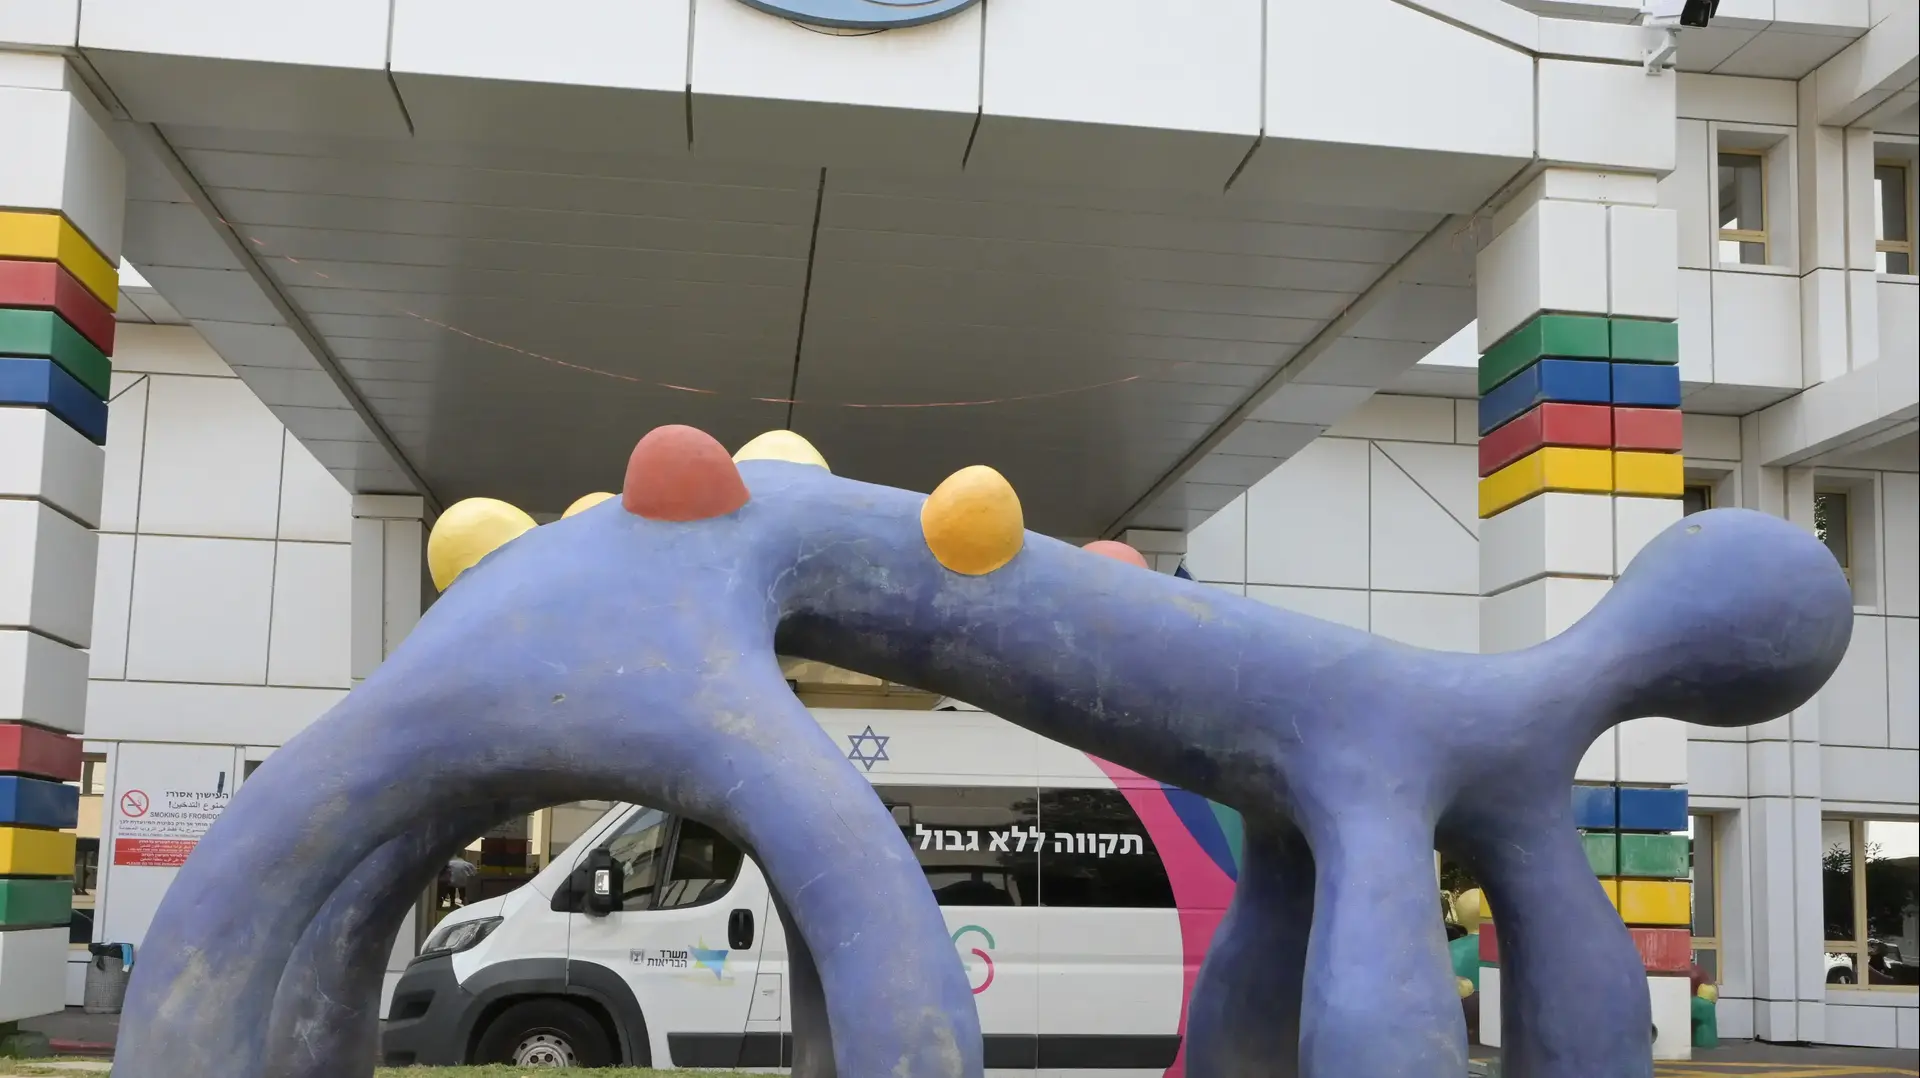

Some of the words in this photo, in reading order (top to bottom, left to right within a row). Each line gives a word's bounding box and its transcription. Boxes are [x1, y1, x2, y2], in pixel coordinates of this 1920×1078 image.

[196, 792, 229, 800] העישון
[149, 811, 180, 819] SMOKING
[188, 812, 220, 820] FROBIDD
[915, 823, 980, 852] גבול
[988, 825, 1046, 853] ללא
[1054, 831, 1144, 858] תקווה
[660, 949, 688, 959] משרד
[647, 958, 688, 968] הבריאות
